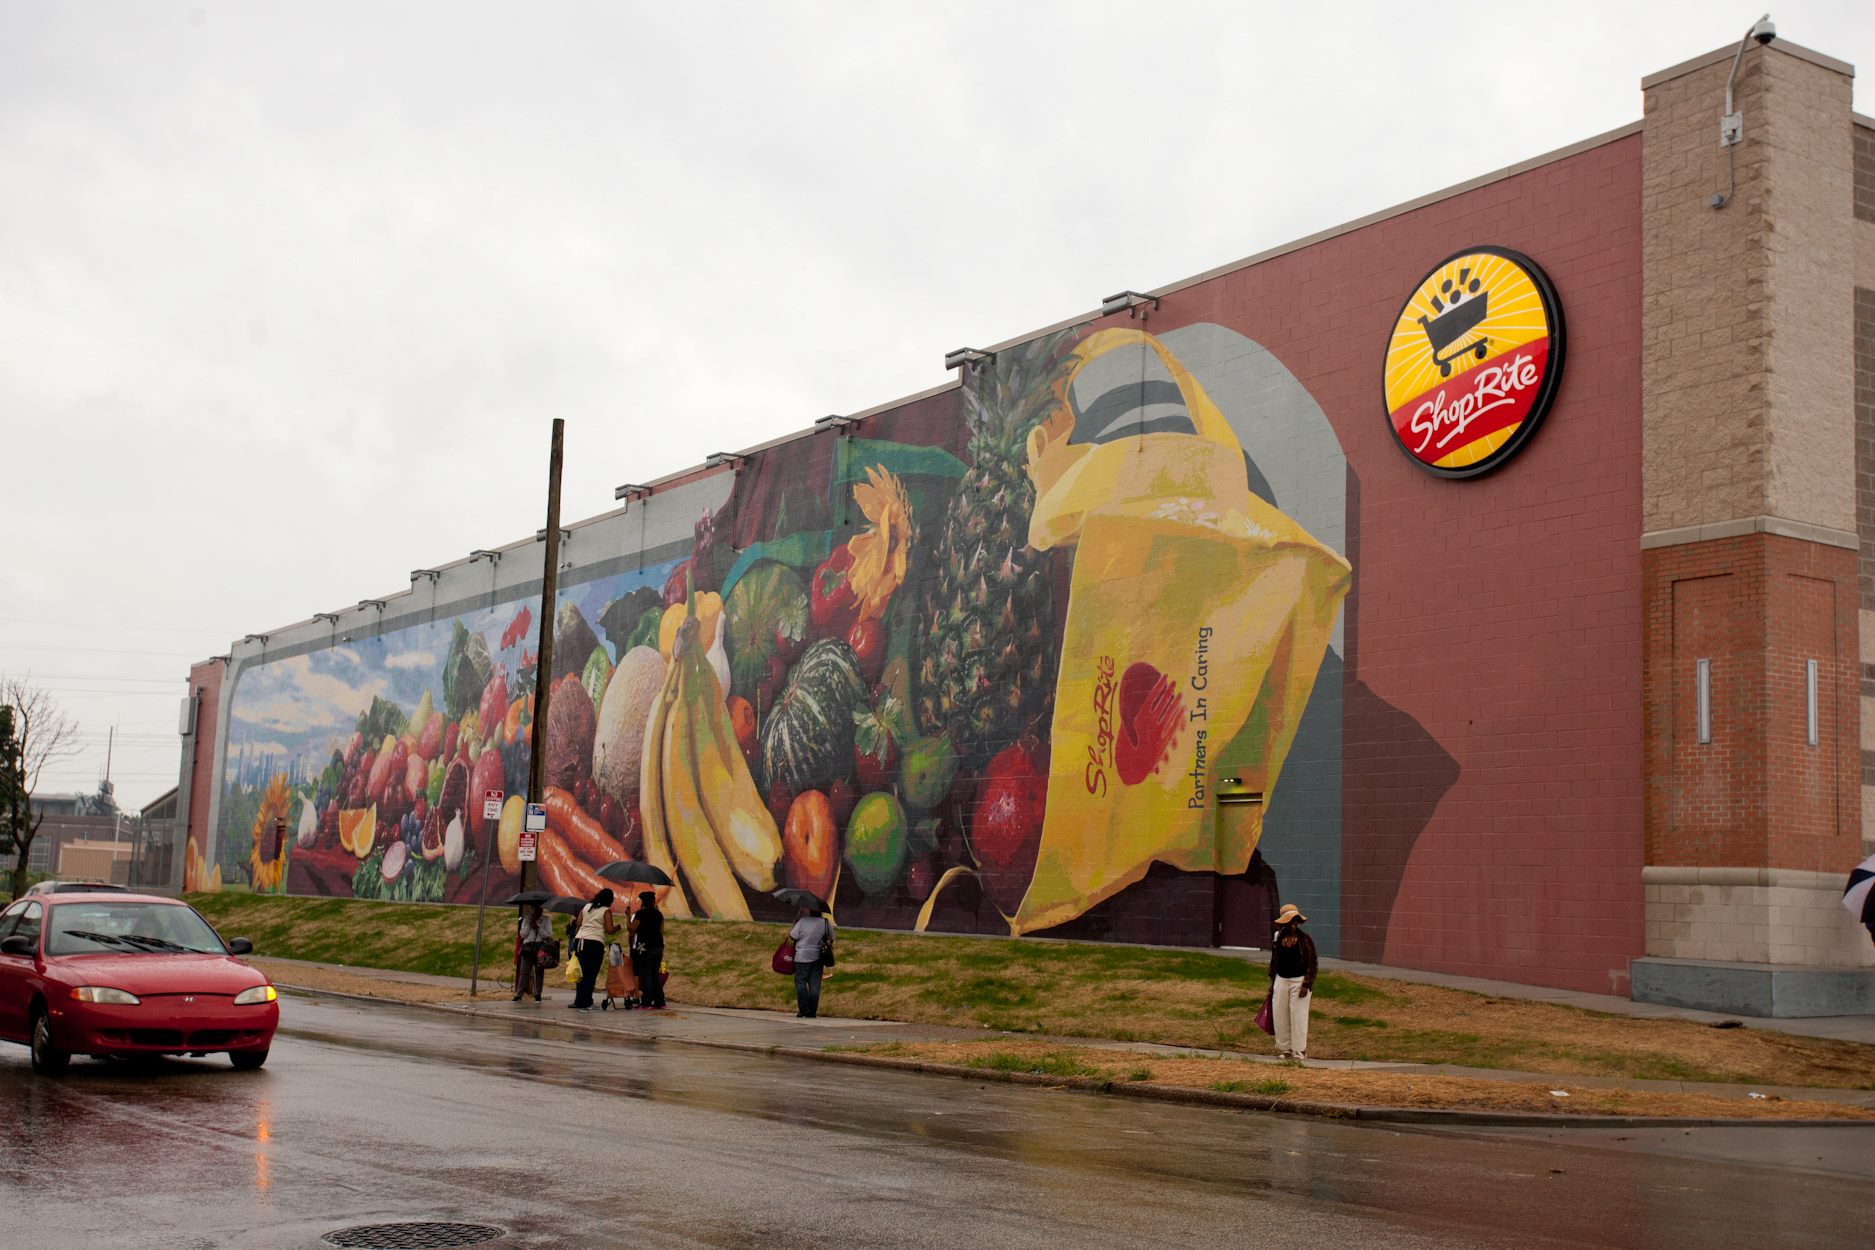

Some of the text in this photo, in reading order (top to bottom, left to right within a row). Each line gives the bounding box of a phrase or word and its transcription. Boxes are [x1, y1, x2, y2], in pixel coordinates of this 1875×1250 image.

[1410, 354, 1539, 453] ShopRite
[1086, 655, 1118, 798] ShopRite
[1188, 626, 1213, 809] Partners In Caring
